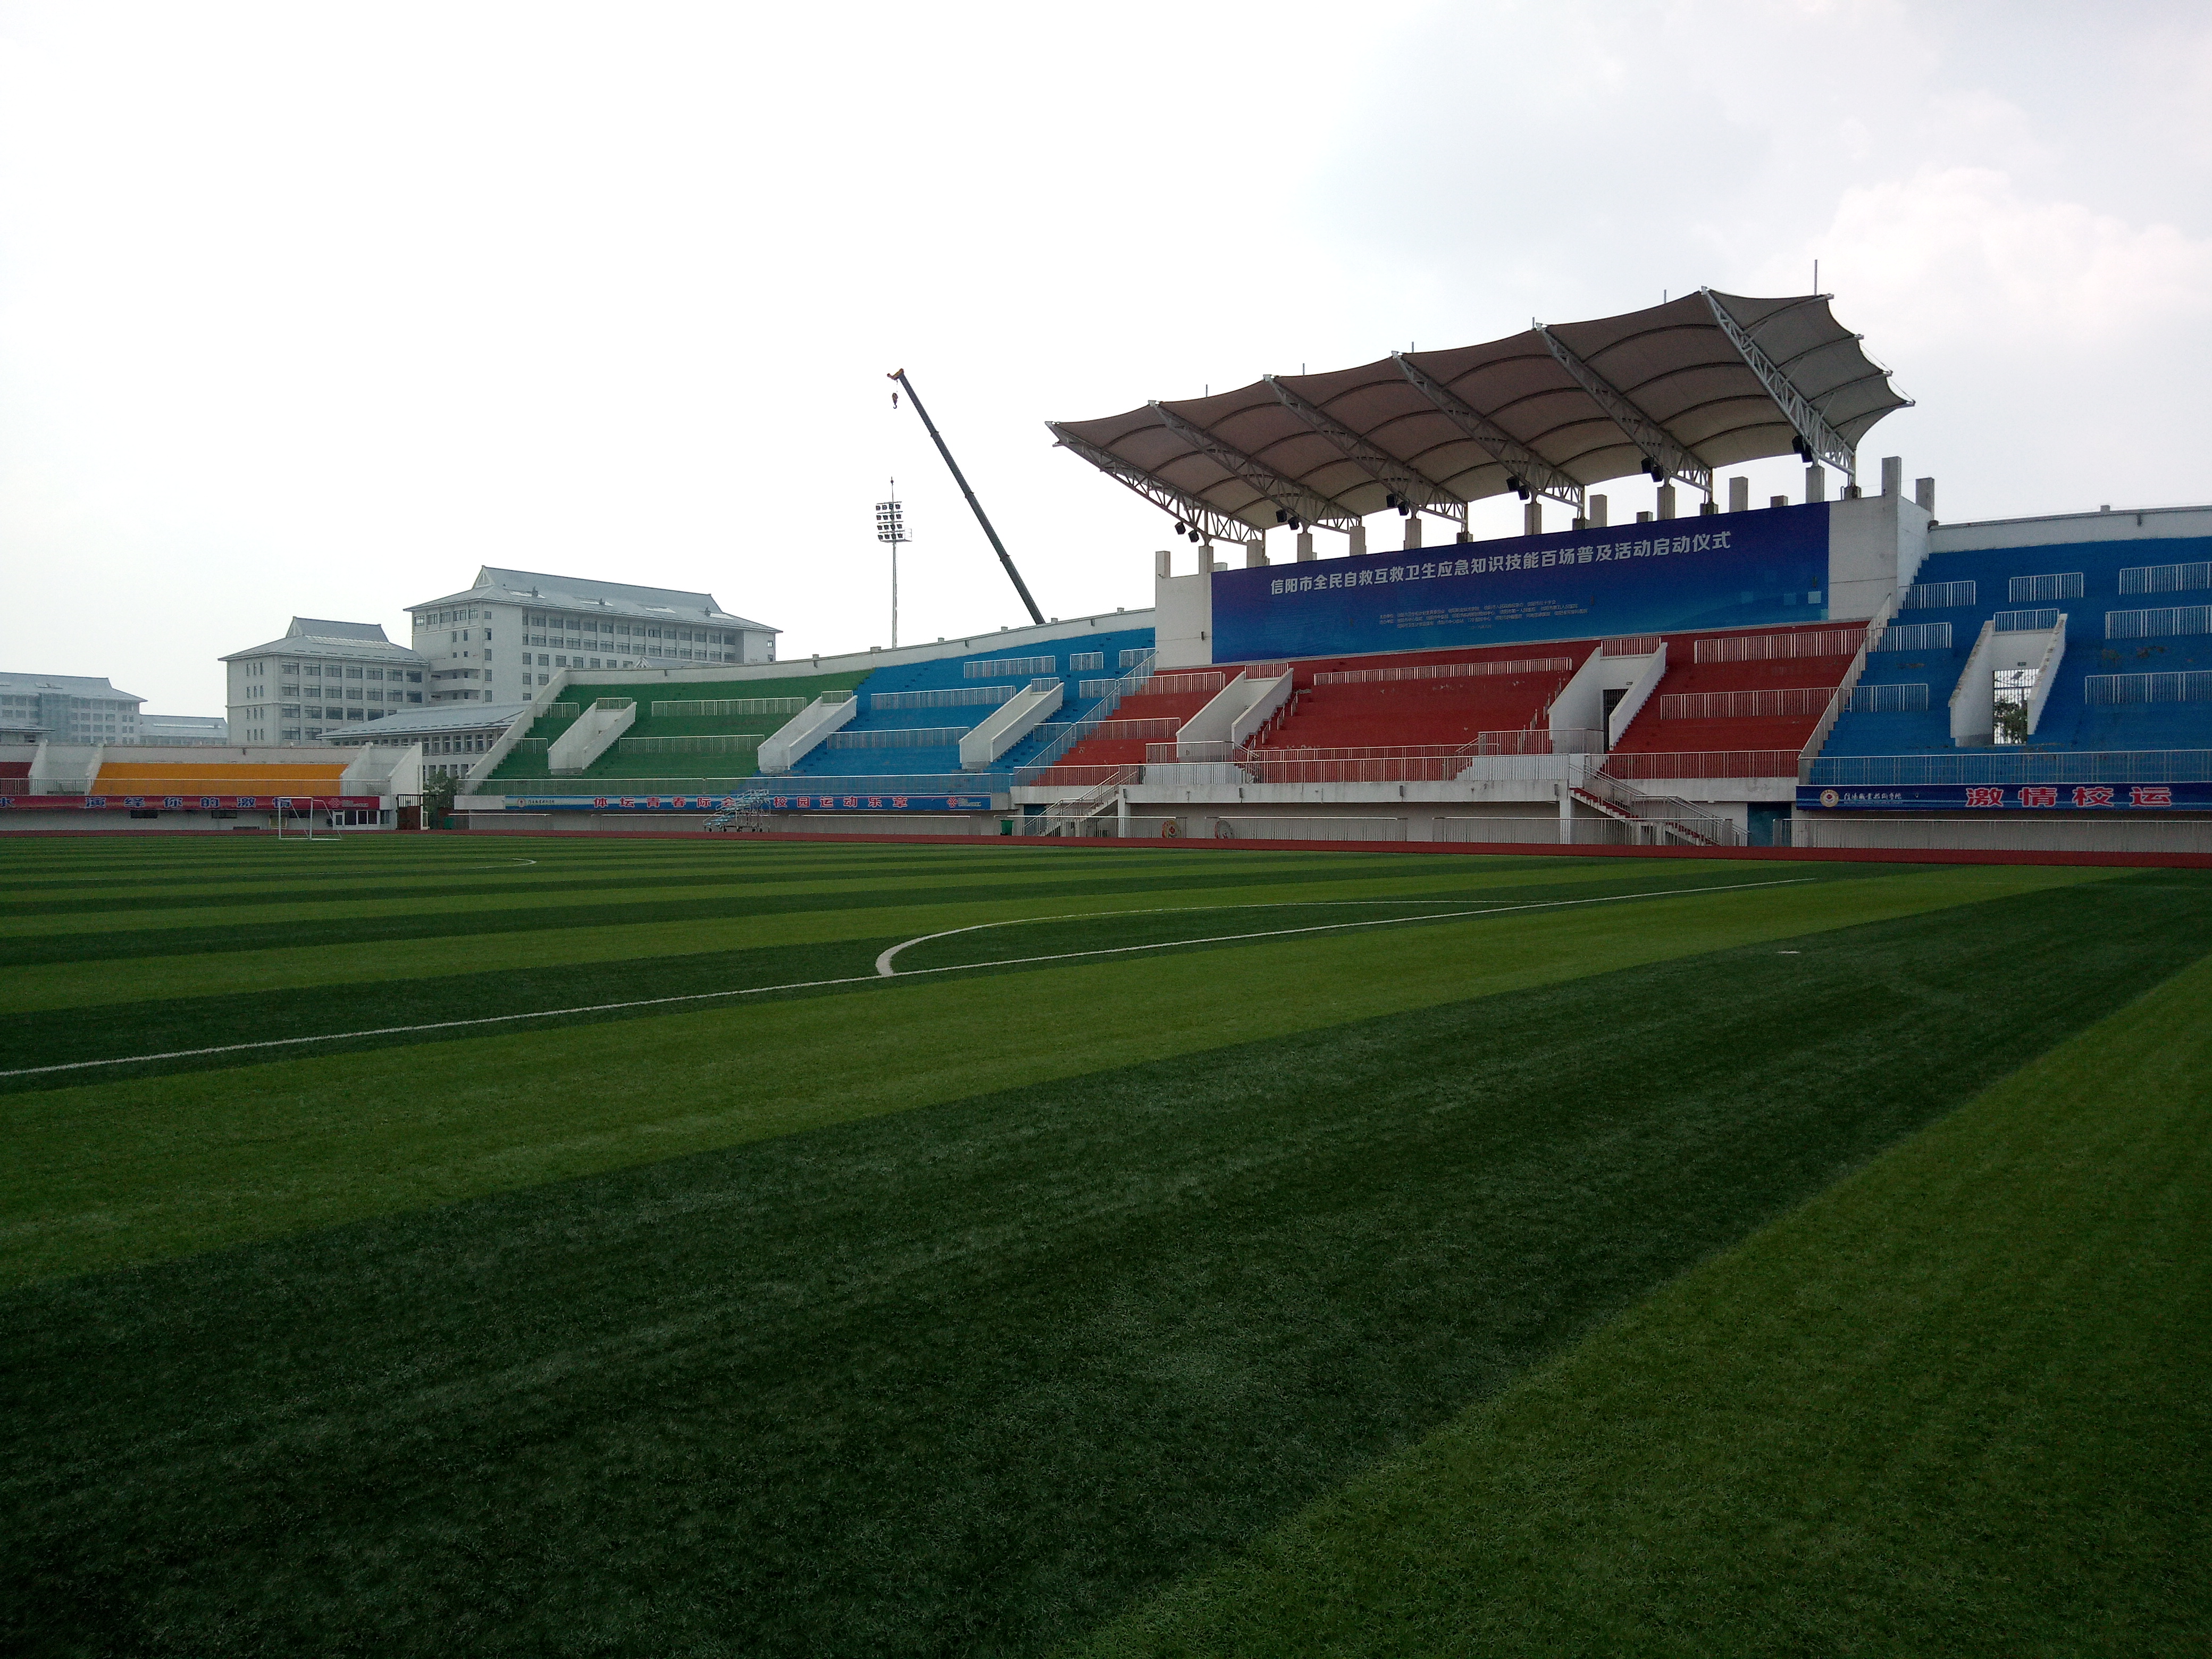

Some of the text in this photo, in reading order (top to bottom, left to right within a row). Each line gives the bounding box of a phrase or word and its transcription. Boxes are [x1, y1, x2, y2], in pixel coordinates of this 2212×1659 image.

[1270, 531, 1731, 595] 信阳市全民自救互救卫生应急知识技能百场普及活动启动仪式
[774, 796, 908, 808] 校园运动乐章
[1966, 787, 2172, 807] 激情校运
